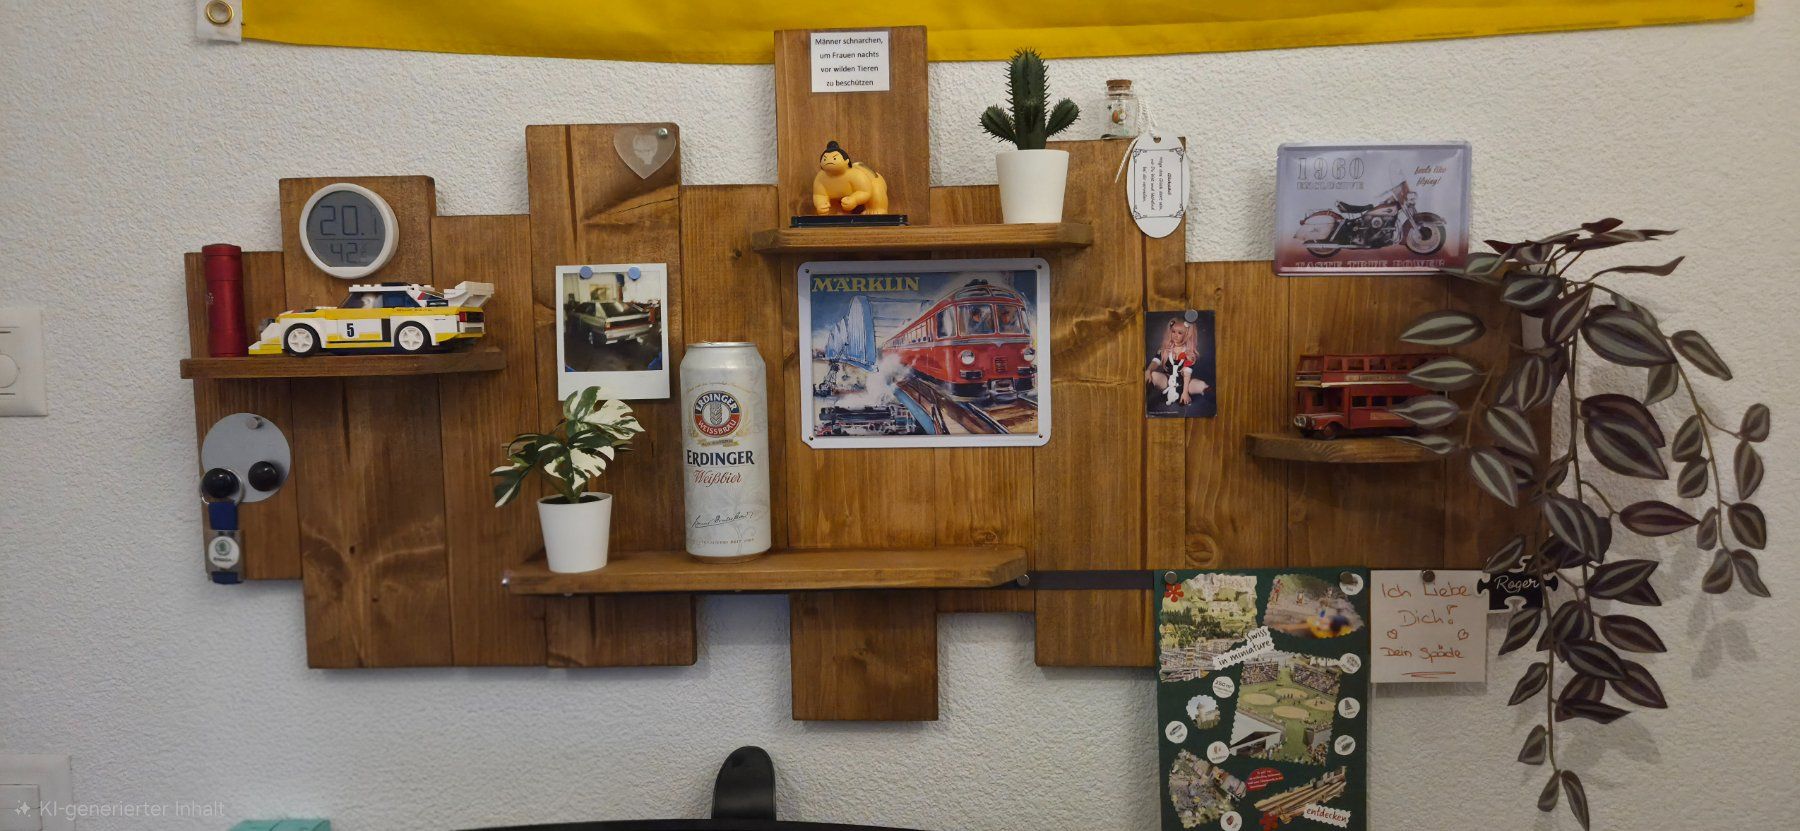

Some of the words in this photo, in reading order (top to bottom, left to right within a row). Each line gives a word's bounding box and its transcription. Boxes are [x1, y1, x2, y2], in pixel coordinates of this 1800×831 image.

[815, 37, 841, 45] Männer
[843, 37, 883, 45] schnarchen,
[833, 65, 855, 73] wilden
[836, 79, 874, 87] beschützen
[1297, 157, 1365, 181] 1960
[319, 205, 378, 236] 20.1
[811, 276, 920, 293] MÄRKLIN
[346, 322, 355, 338] 5
[695, 393, 738, 412] ERDINGER
[687, 449, 755, 466] ERDINGER
[693, 469, 743, 488] Weißbier
[1381, 583, 1412, 598] Ich
[1423, 581, 1472, 597] Liebe
[1494, 575, 1540, 594] Roger
[1398, 604, 1459, 627] Dich!
[1217, 656, 1228, 666] in
[1229, 640, 1272, 662] miniature
[1380, 646, 1413, 659] Dein
[1306, 806, 1347, 823] entdecken
